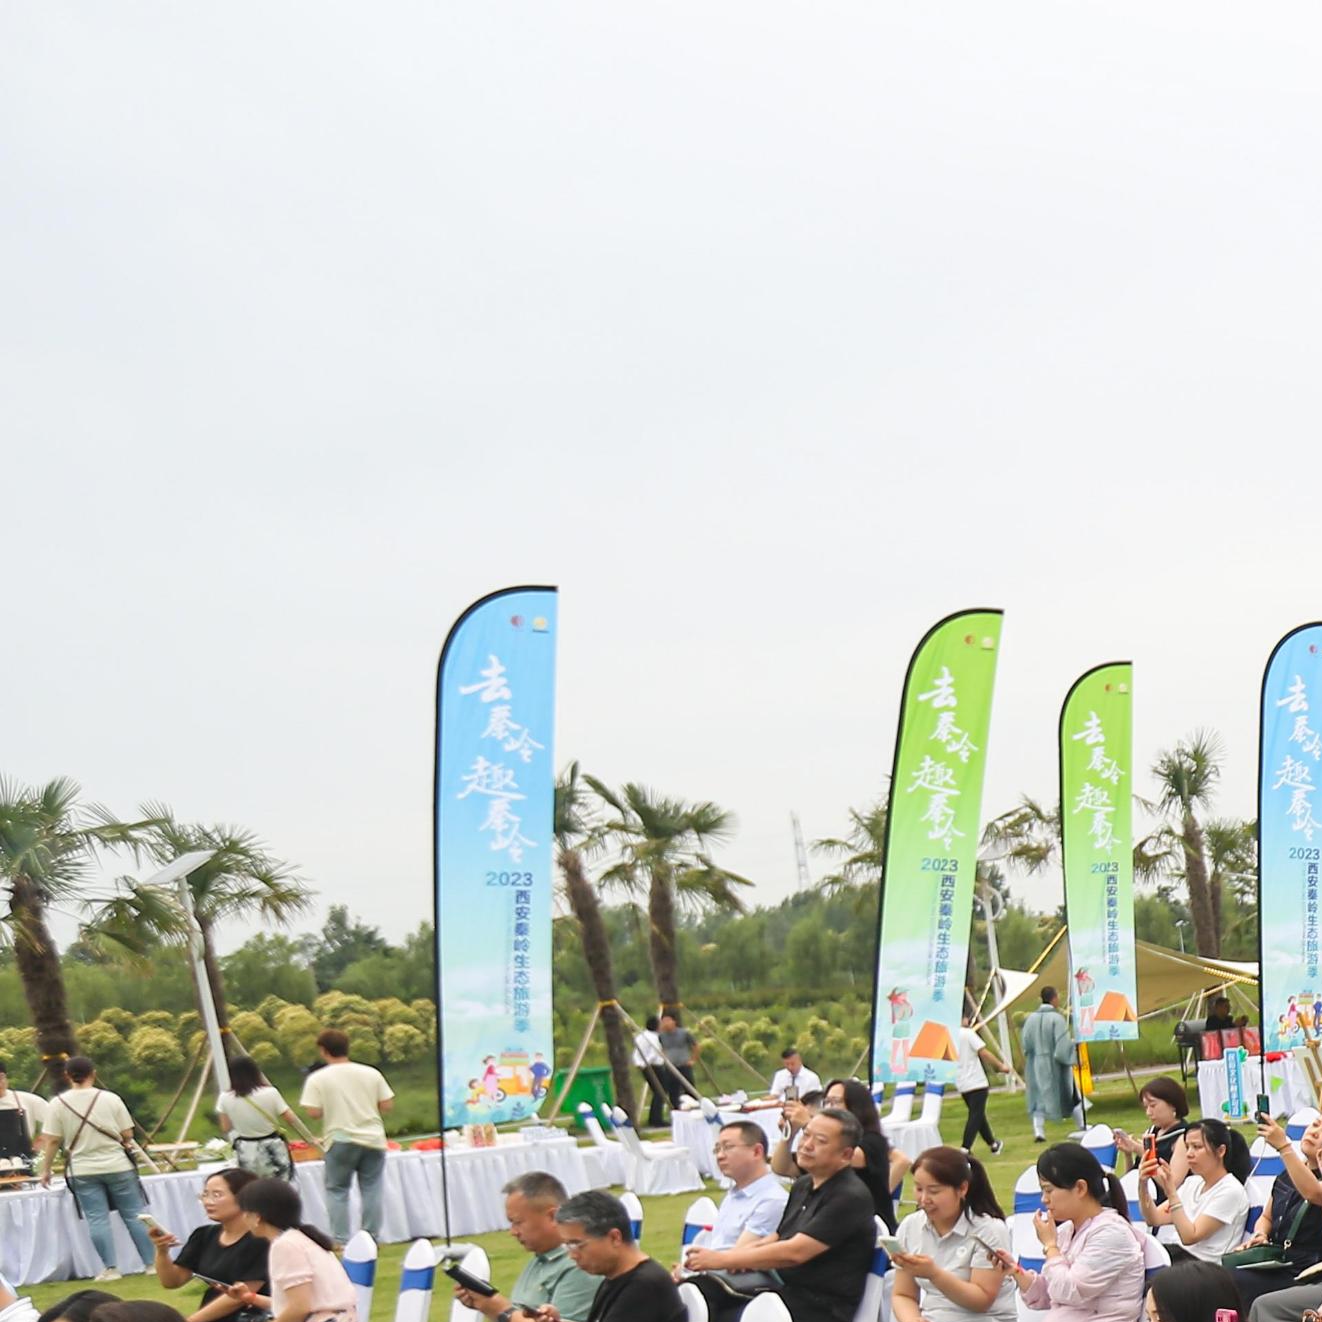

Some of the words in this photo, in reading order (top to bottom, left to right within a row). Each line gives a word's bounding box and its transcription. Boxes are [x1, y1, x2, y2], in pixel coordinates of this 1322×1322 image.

[1289, 847, 1320, 860] 2023
[921, 858, 959, 872] 2023
[486, 872, 533, 887] 2023
[513, 889, 531, 1034] 西安秦岭生态旅游季
